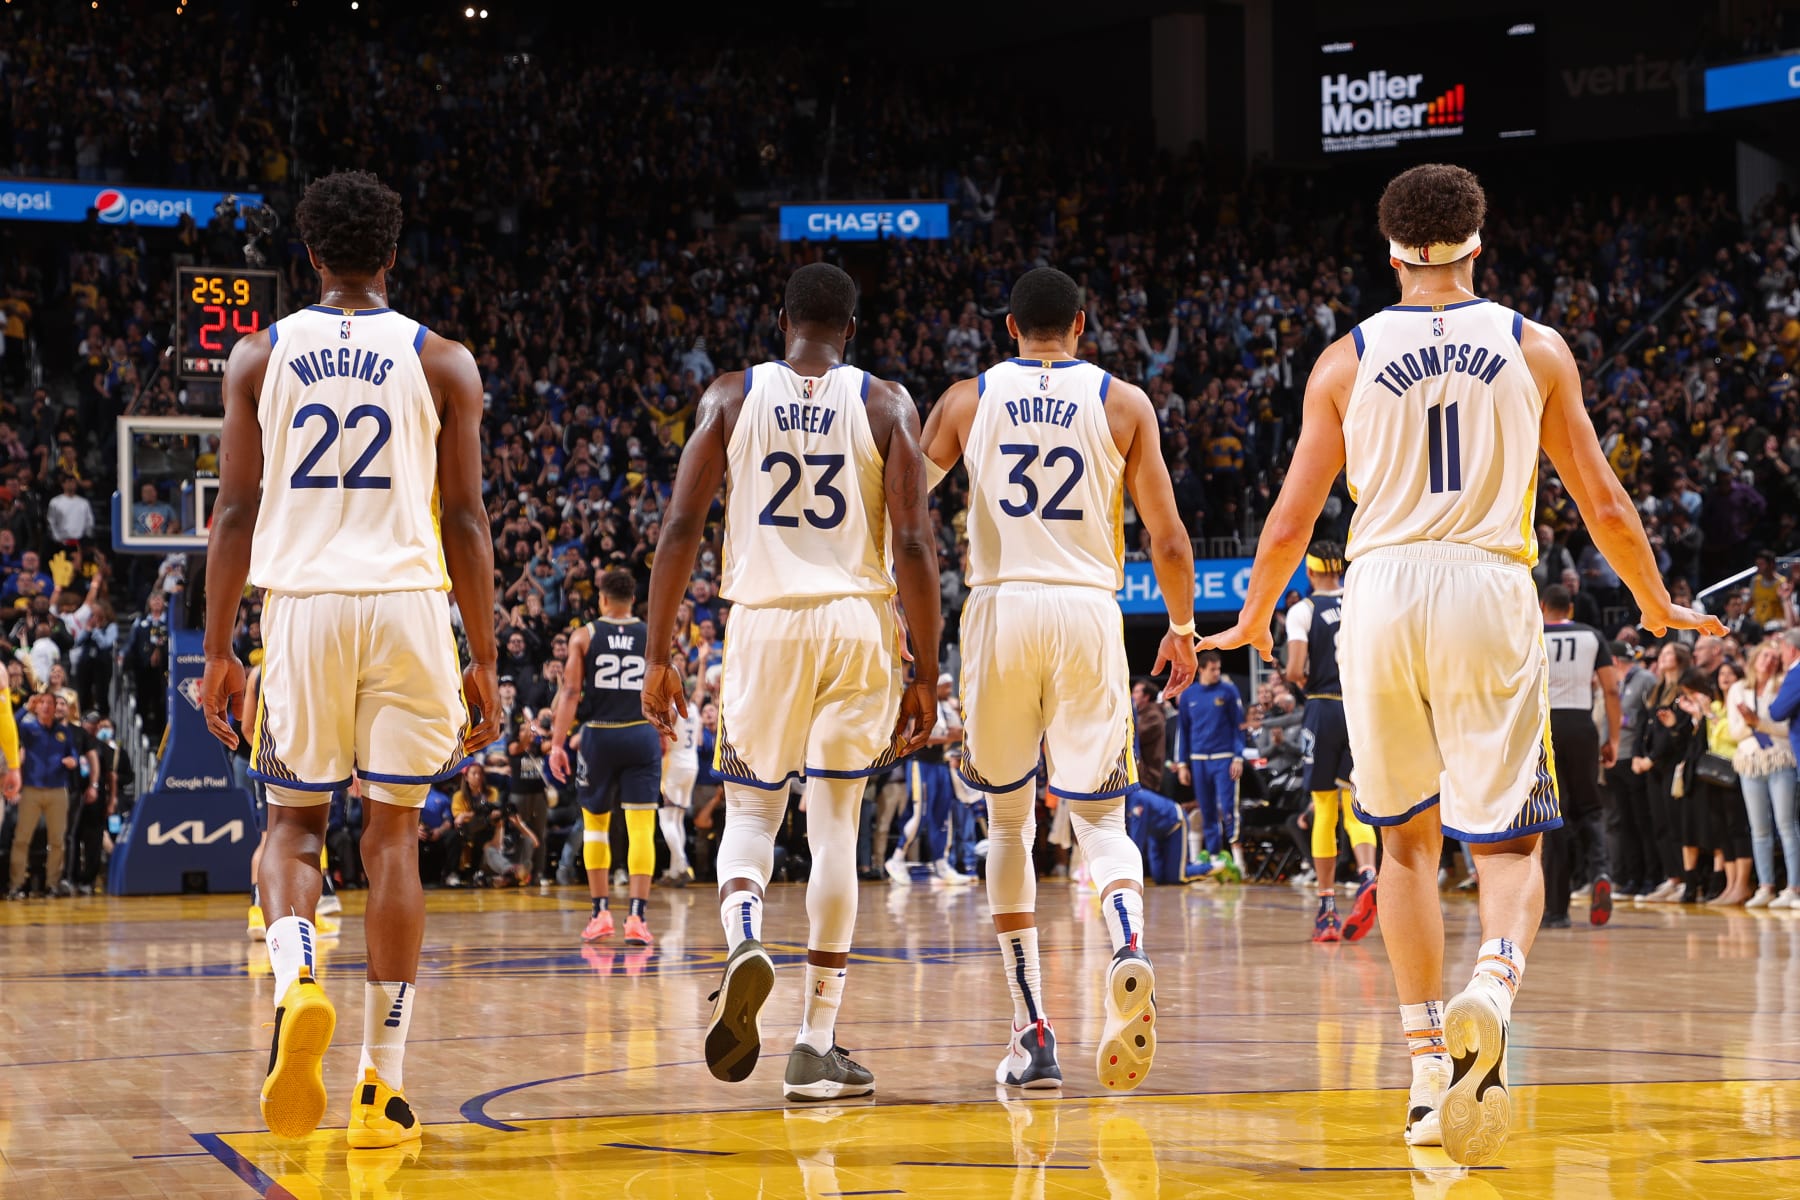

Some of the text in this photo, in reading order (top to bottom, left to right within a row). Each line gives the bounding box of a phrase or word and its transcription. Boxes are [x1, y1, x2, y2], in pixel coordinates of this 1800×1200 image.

[1321, 70, 1423, 104] Holier
[1560, 53, 1686, 98] veriz
[1321, 100, 1428, 135] Molier
[0, 191, 52, 214] epsi
[129, 198, 193, 220] pepsi
[808, 211, 894, 233] CHASE
[191, 277, 250, 306] 25.9
[199, 305, 259, 351] 24
[288, 347, 394, 387] WIGGINS
[1374, 343, 1508, 398] THOMPSON
[774, 403, 837, 436] GREEN
[1005, 397, 1079, 429] PORTER
[290, 403, 392, 490] 22
[1427, 400, 1462, 494] 11
[758, 451, 848, 530] 23
[998, 443, 1085, 521] 32
[1551, 637, 1576, 662] 77
[594, 653, 646, 691] 22
[165, 776, 228, 791] Google Pixel
[147, 819, 244, 846] KIA
